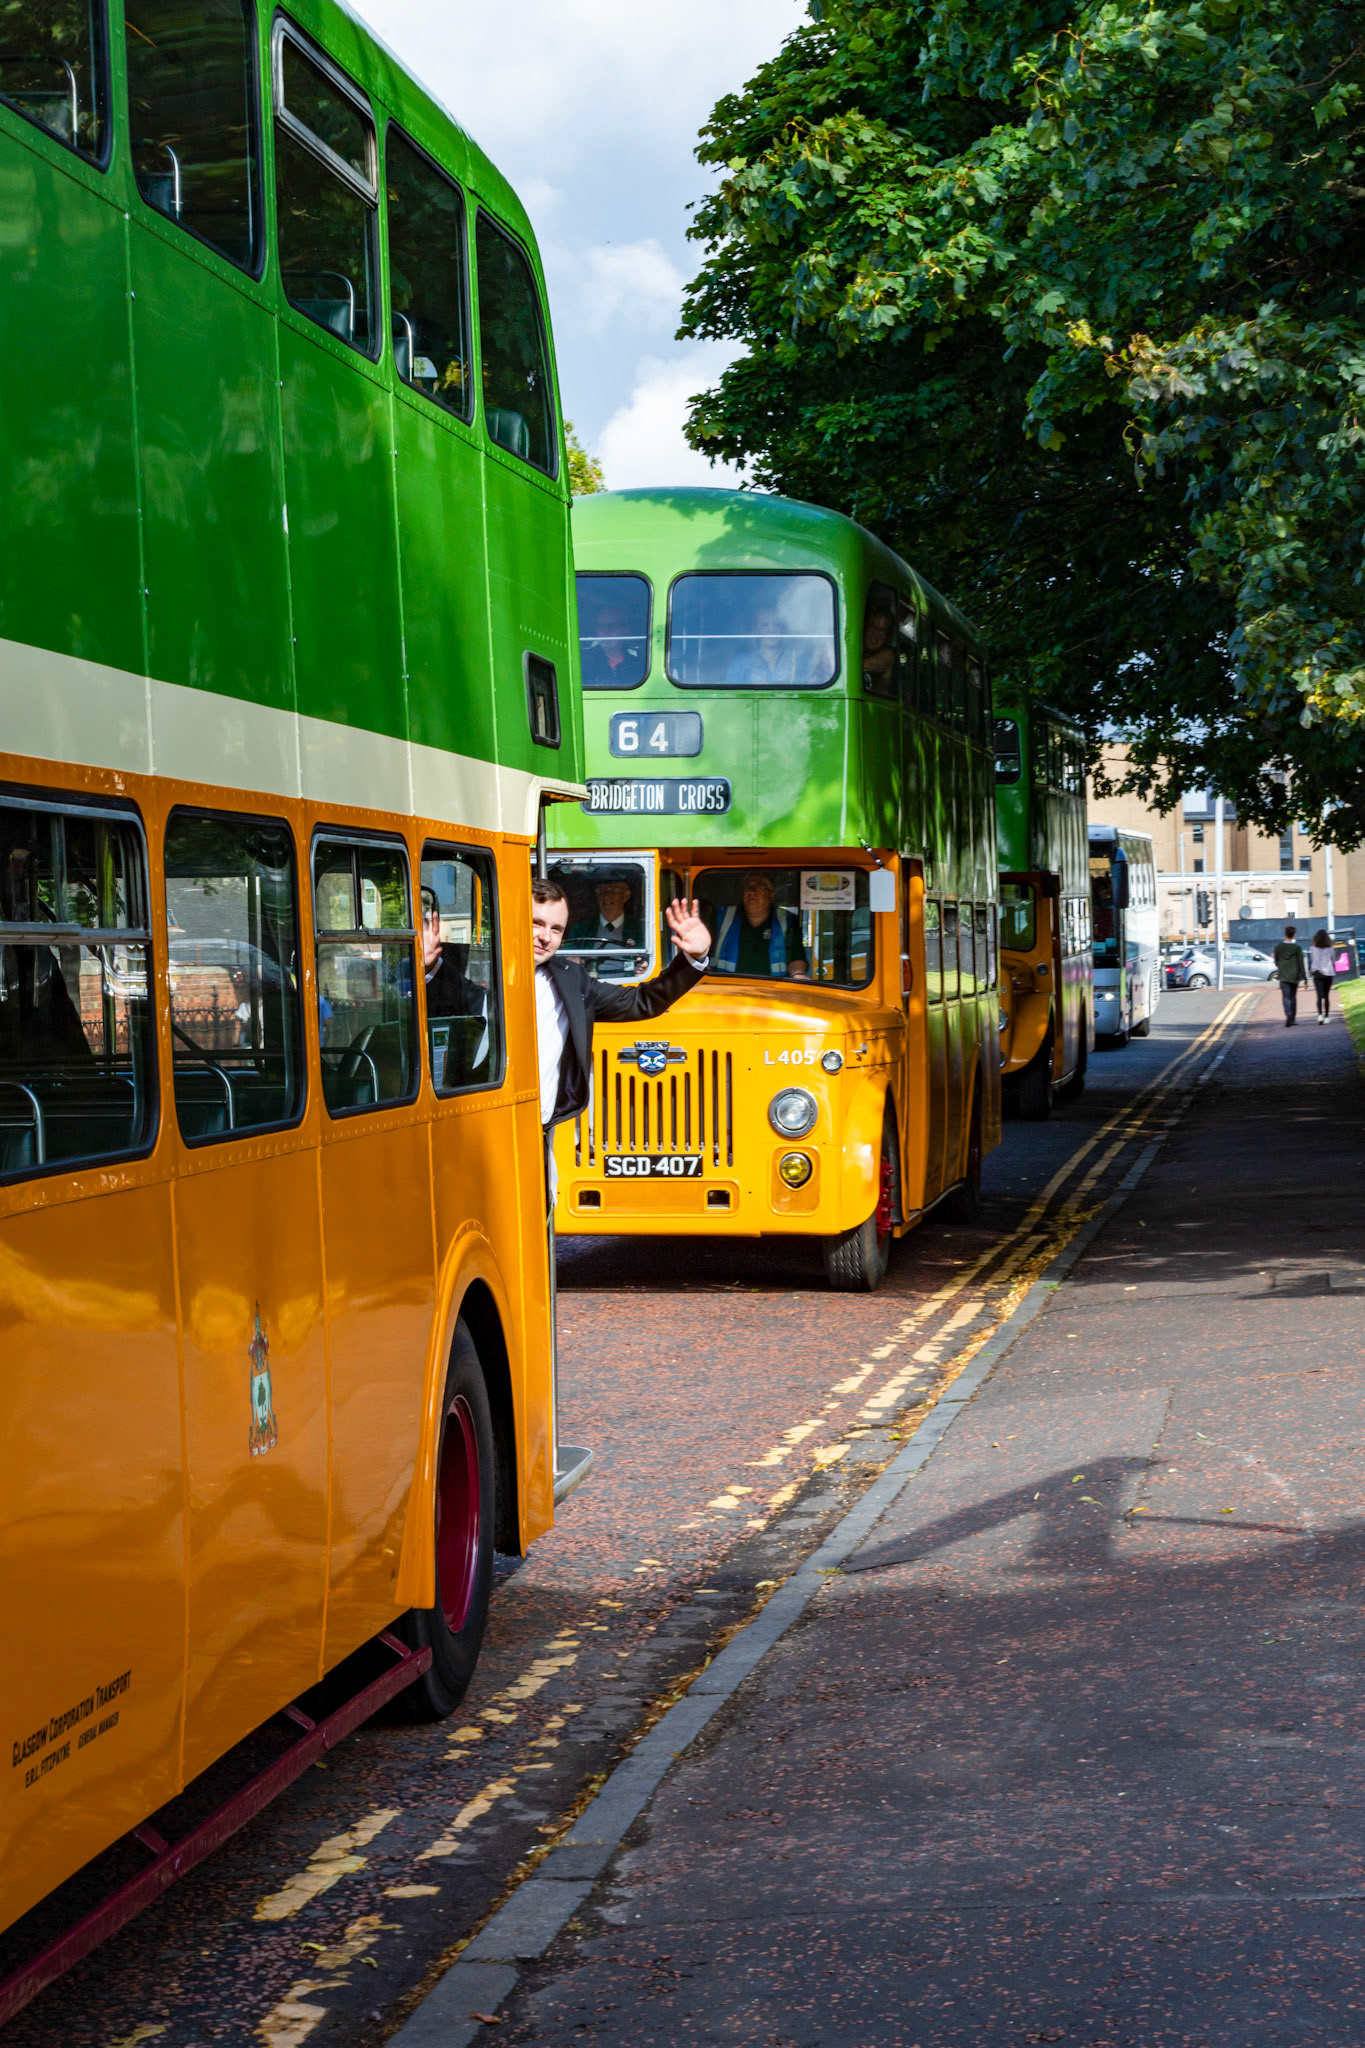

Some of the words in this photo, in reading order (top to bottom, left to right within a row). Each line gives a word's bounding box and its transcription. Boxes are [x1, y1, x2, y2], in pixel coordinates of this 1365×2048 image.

[618, 721, 669, 752] 64
[590, 784, 665, 810] BRIDGETON
[678, 784, 725, 810] CROSS
[763, 1050, 815, 1065] L405
[12, 1726, 49, 1768] GLASGOW
[49, 1694, 95, 1742] CORPORATION
[96, 1670, 132, 1710] TRANSPORT
